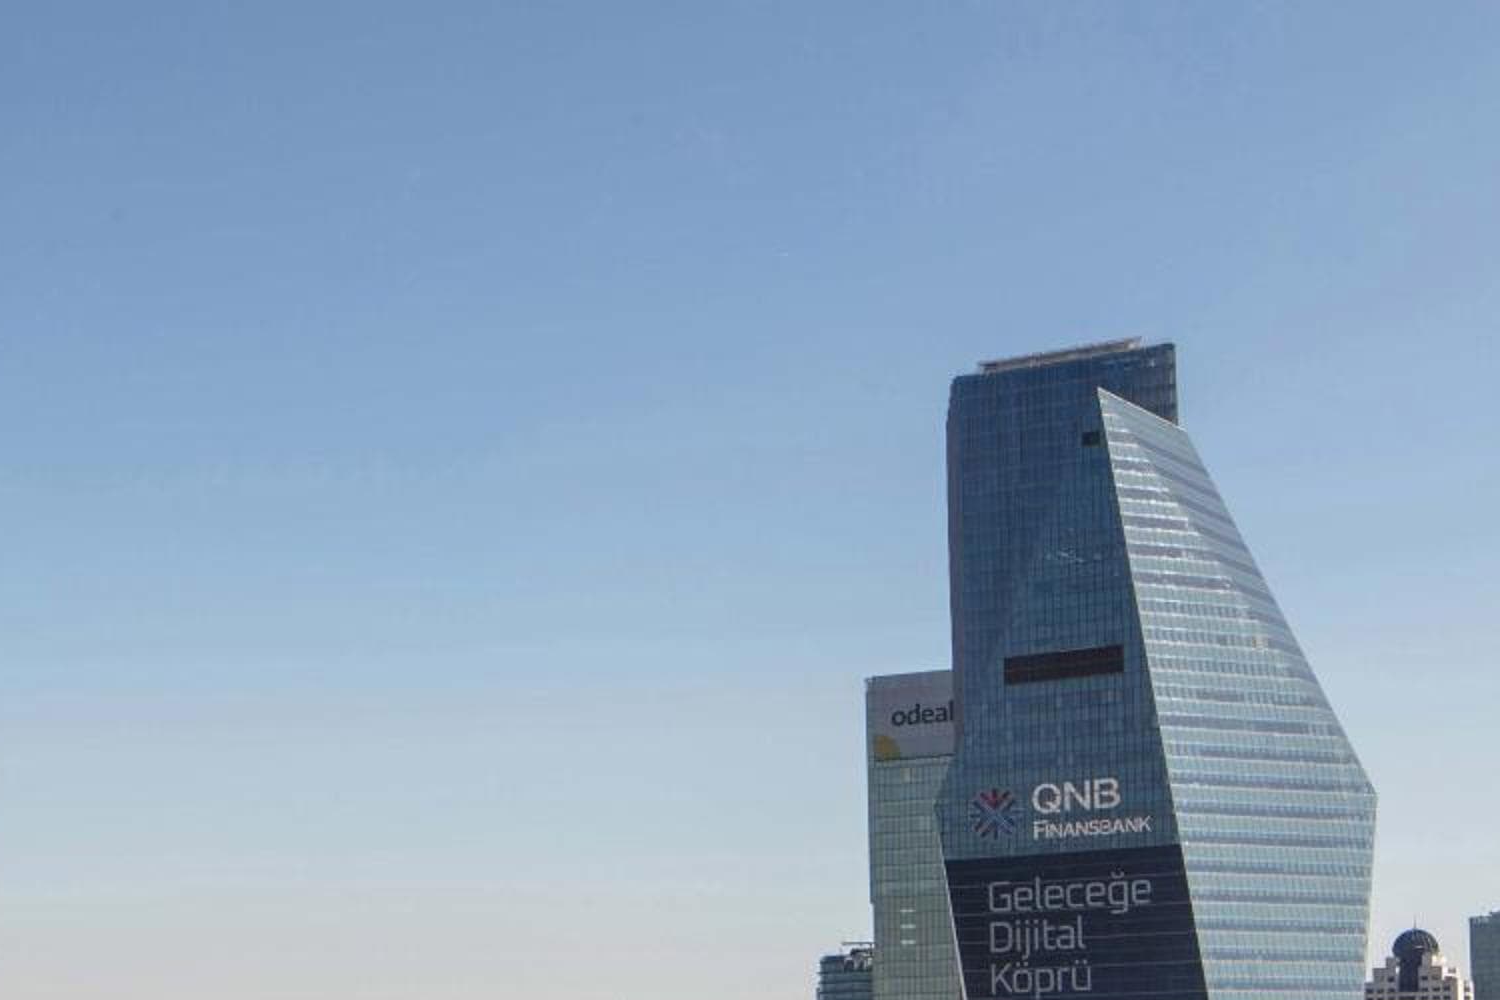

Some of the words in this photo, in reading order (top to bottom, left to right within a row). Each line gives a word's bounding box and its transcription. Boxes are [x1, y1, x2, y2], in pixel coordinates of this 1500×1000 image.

[1031, 777, 1121, 814] QNB
[988, 871, 1152, 915] Geleceğe
[989, 914, 1087, 961] Dijital
[990, 959, 1093, 1000] Köprü
